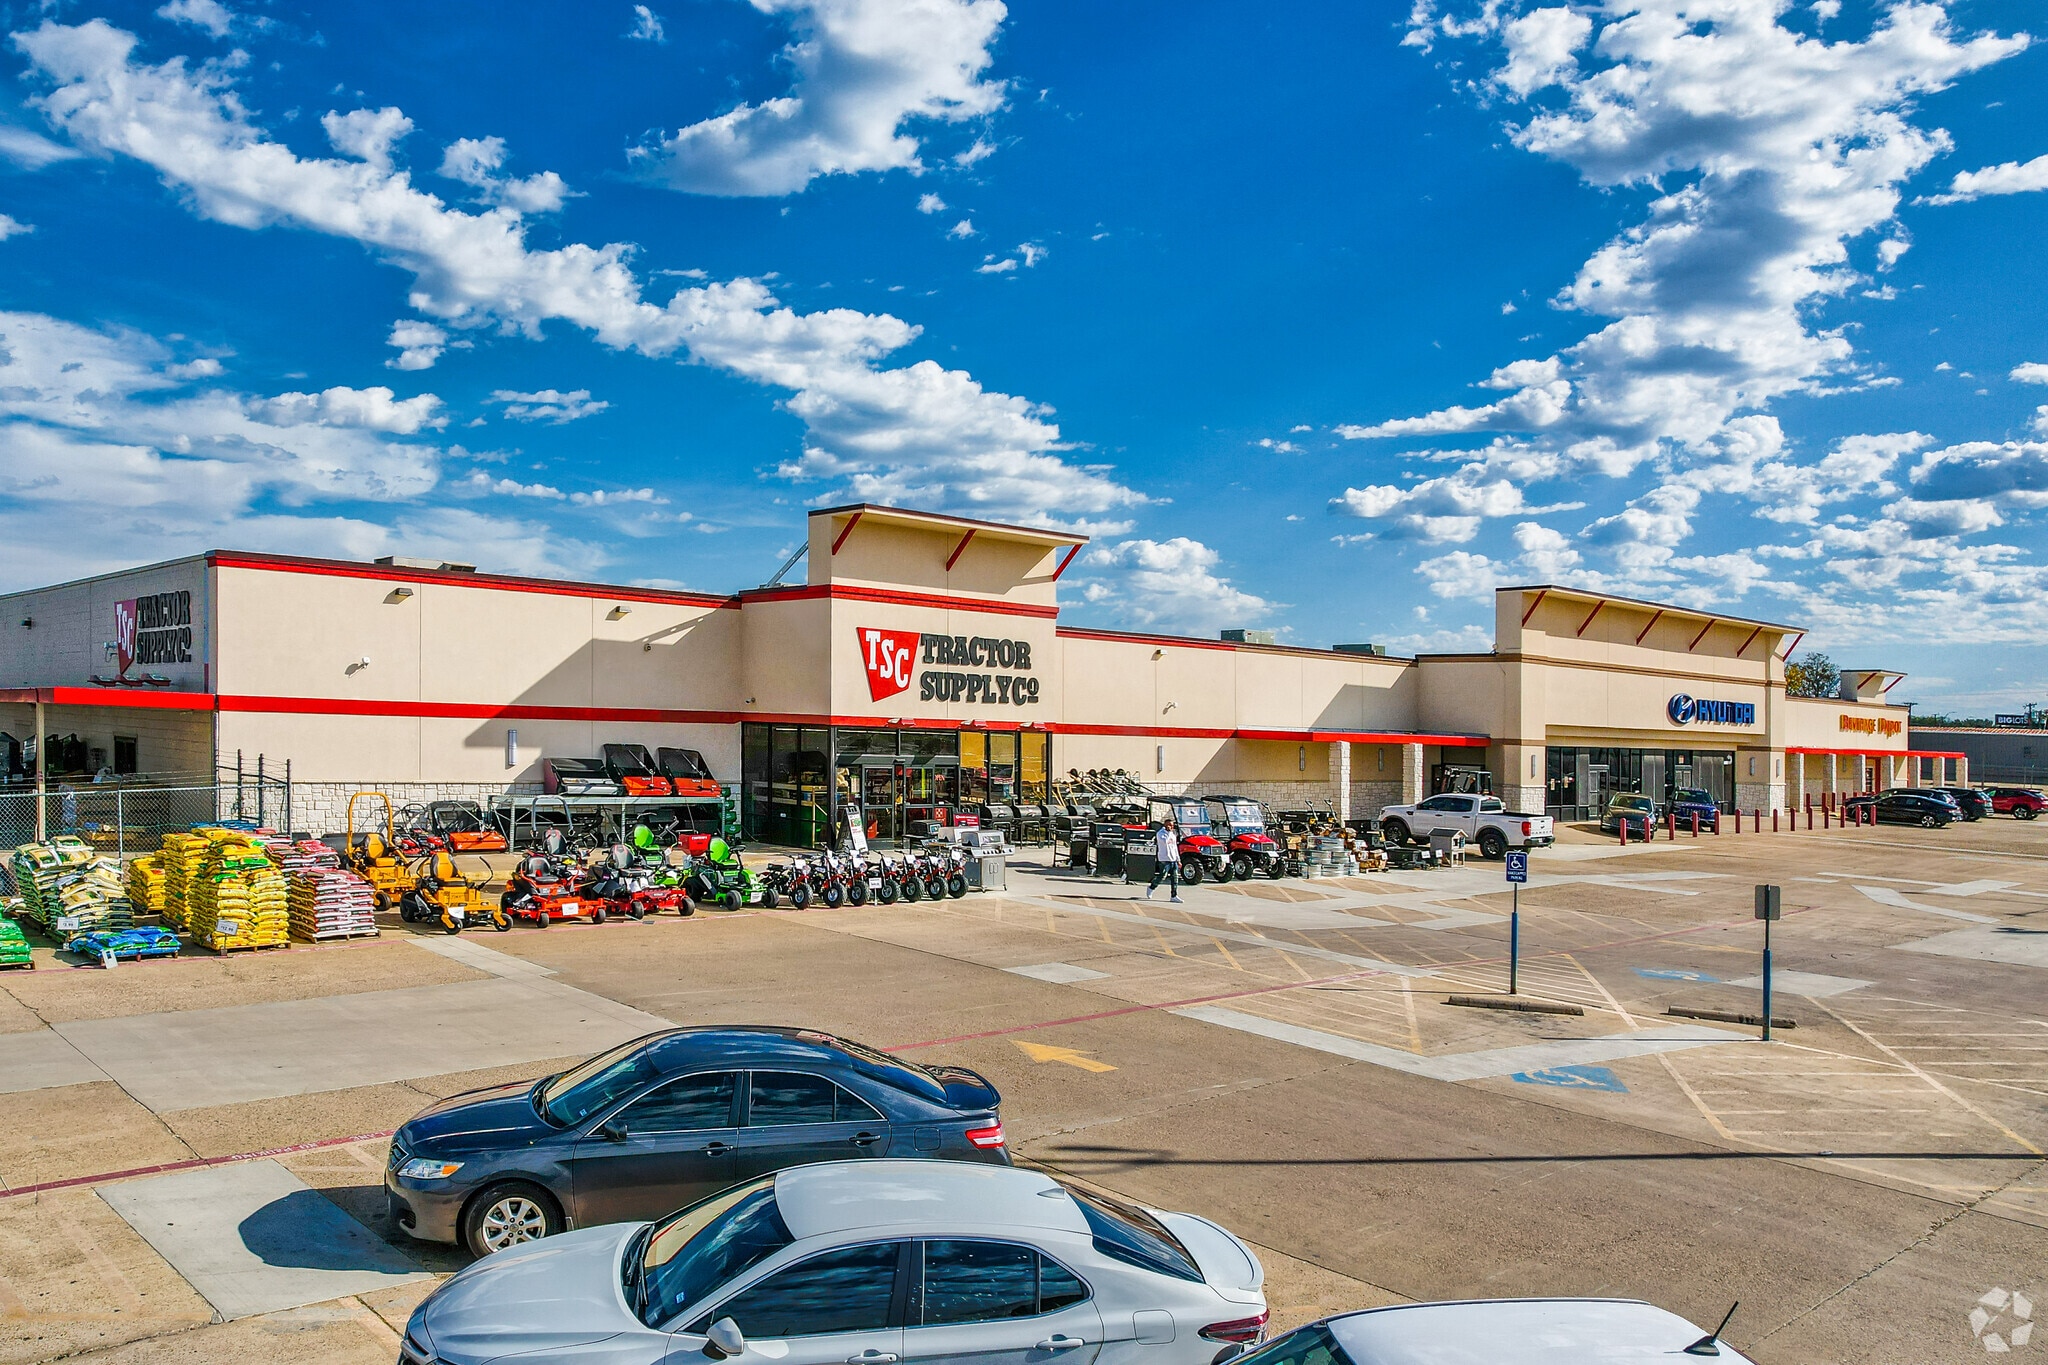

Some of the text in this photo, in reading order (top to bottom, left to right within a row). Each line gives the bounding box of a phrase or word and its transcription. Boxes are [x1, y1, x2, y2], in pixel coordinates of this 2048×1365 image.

[137, 591, 191, 628] TRACTOR
[116, 604, 133, 659] TSC
[866, 630, 909, 688] TSC
[920, 633, 1032, 670] TRACTOR
[1696, 699, 1755, 724] HYUNDAI
